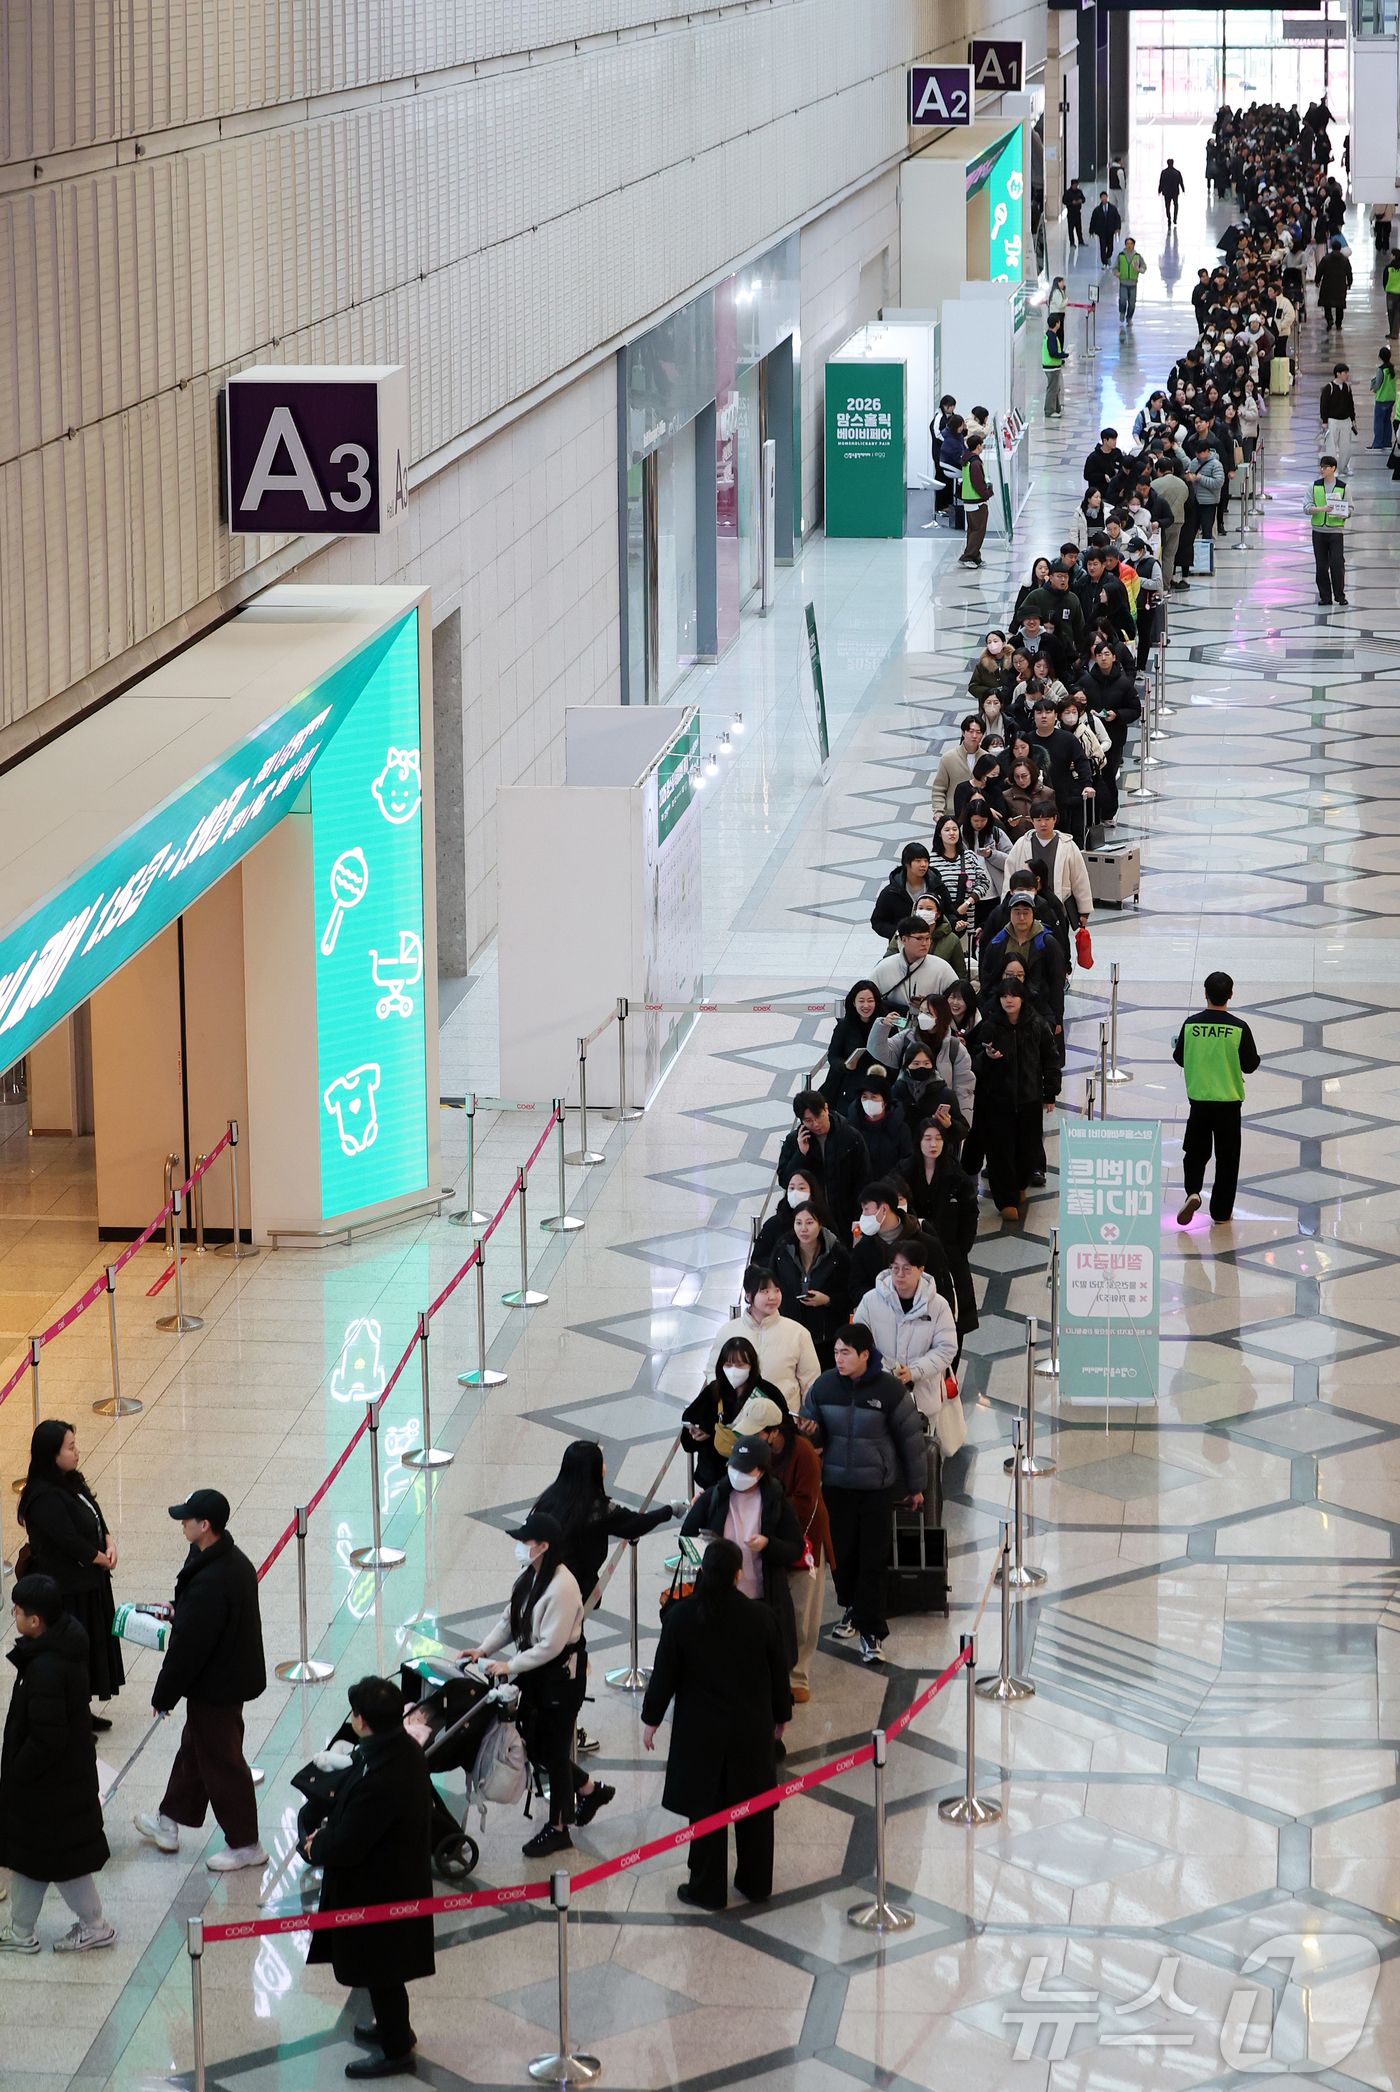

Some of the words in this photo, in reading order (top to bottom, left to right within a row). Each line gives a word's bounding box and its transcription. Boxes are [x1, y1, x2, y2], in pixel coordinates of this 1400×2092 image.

[976, 48, 1018, 84] A1
[915, 76, 967, 118] A2
[847, 398, 881, 411] 2026
[837, 413, 891, 427] 맘스홀릭
[837, 428, 891, 440] 베이비페어
[240, 407, 371, 512] A3
[395, 448, 408, 514] A3
[645, 1003, 664, 1011] coex
[699, 1004, 718, 1012] coex
[753, 1004, 772, 1012] coex
[807, 1003, 826, 1011] coex
[1192, 1026, 1233, 1038] STAFF
[836, 1755, 855, 1772] coex
[786, 1777, 805, 1795] coex
[730, 1801, 750, 1820] coex
[675, 1825, 696, 1844] coex
[620, 1848, 641, 1868] coex
[444, 1893, 473, 1909] coex
[498, 1885, 528, 1901] coex
[335, 1908, 365, 1923] coex
[390, 1901, 420, 1916] coex
[225, 1921, 255, 1937] coex
[280, 1915, 310, 1930] coex
